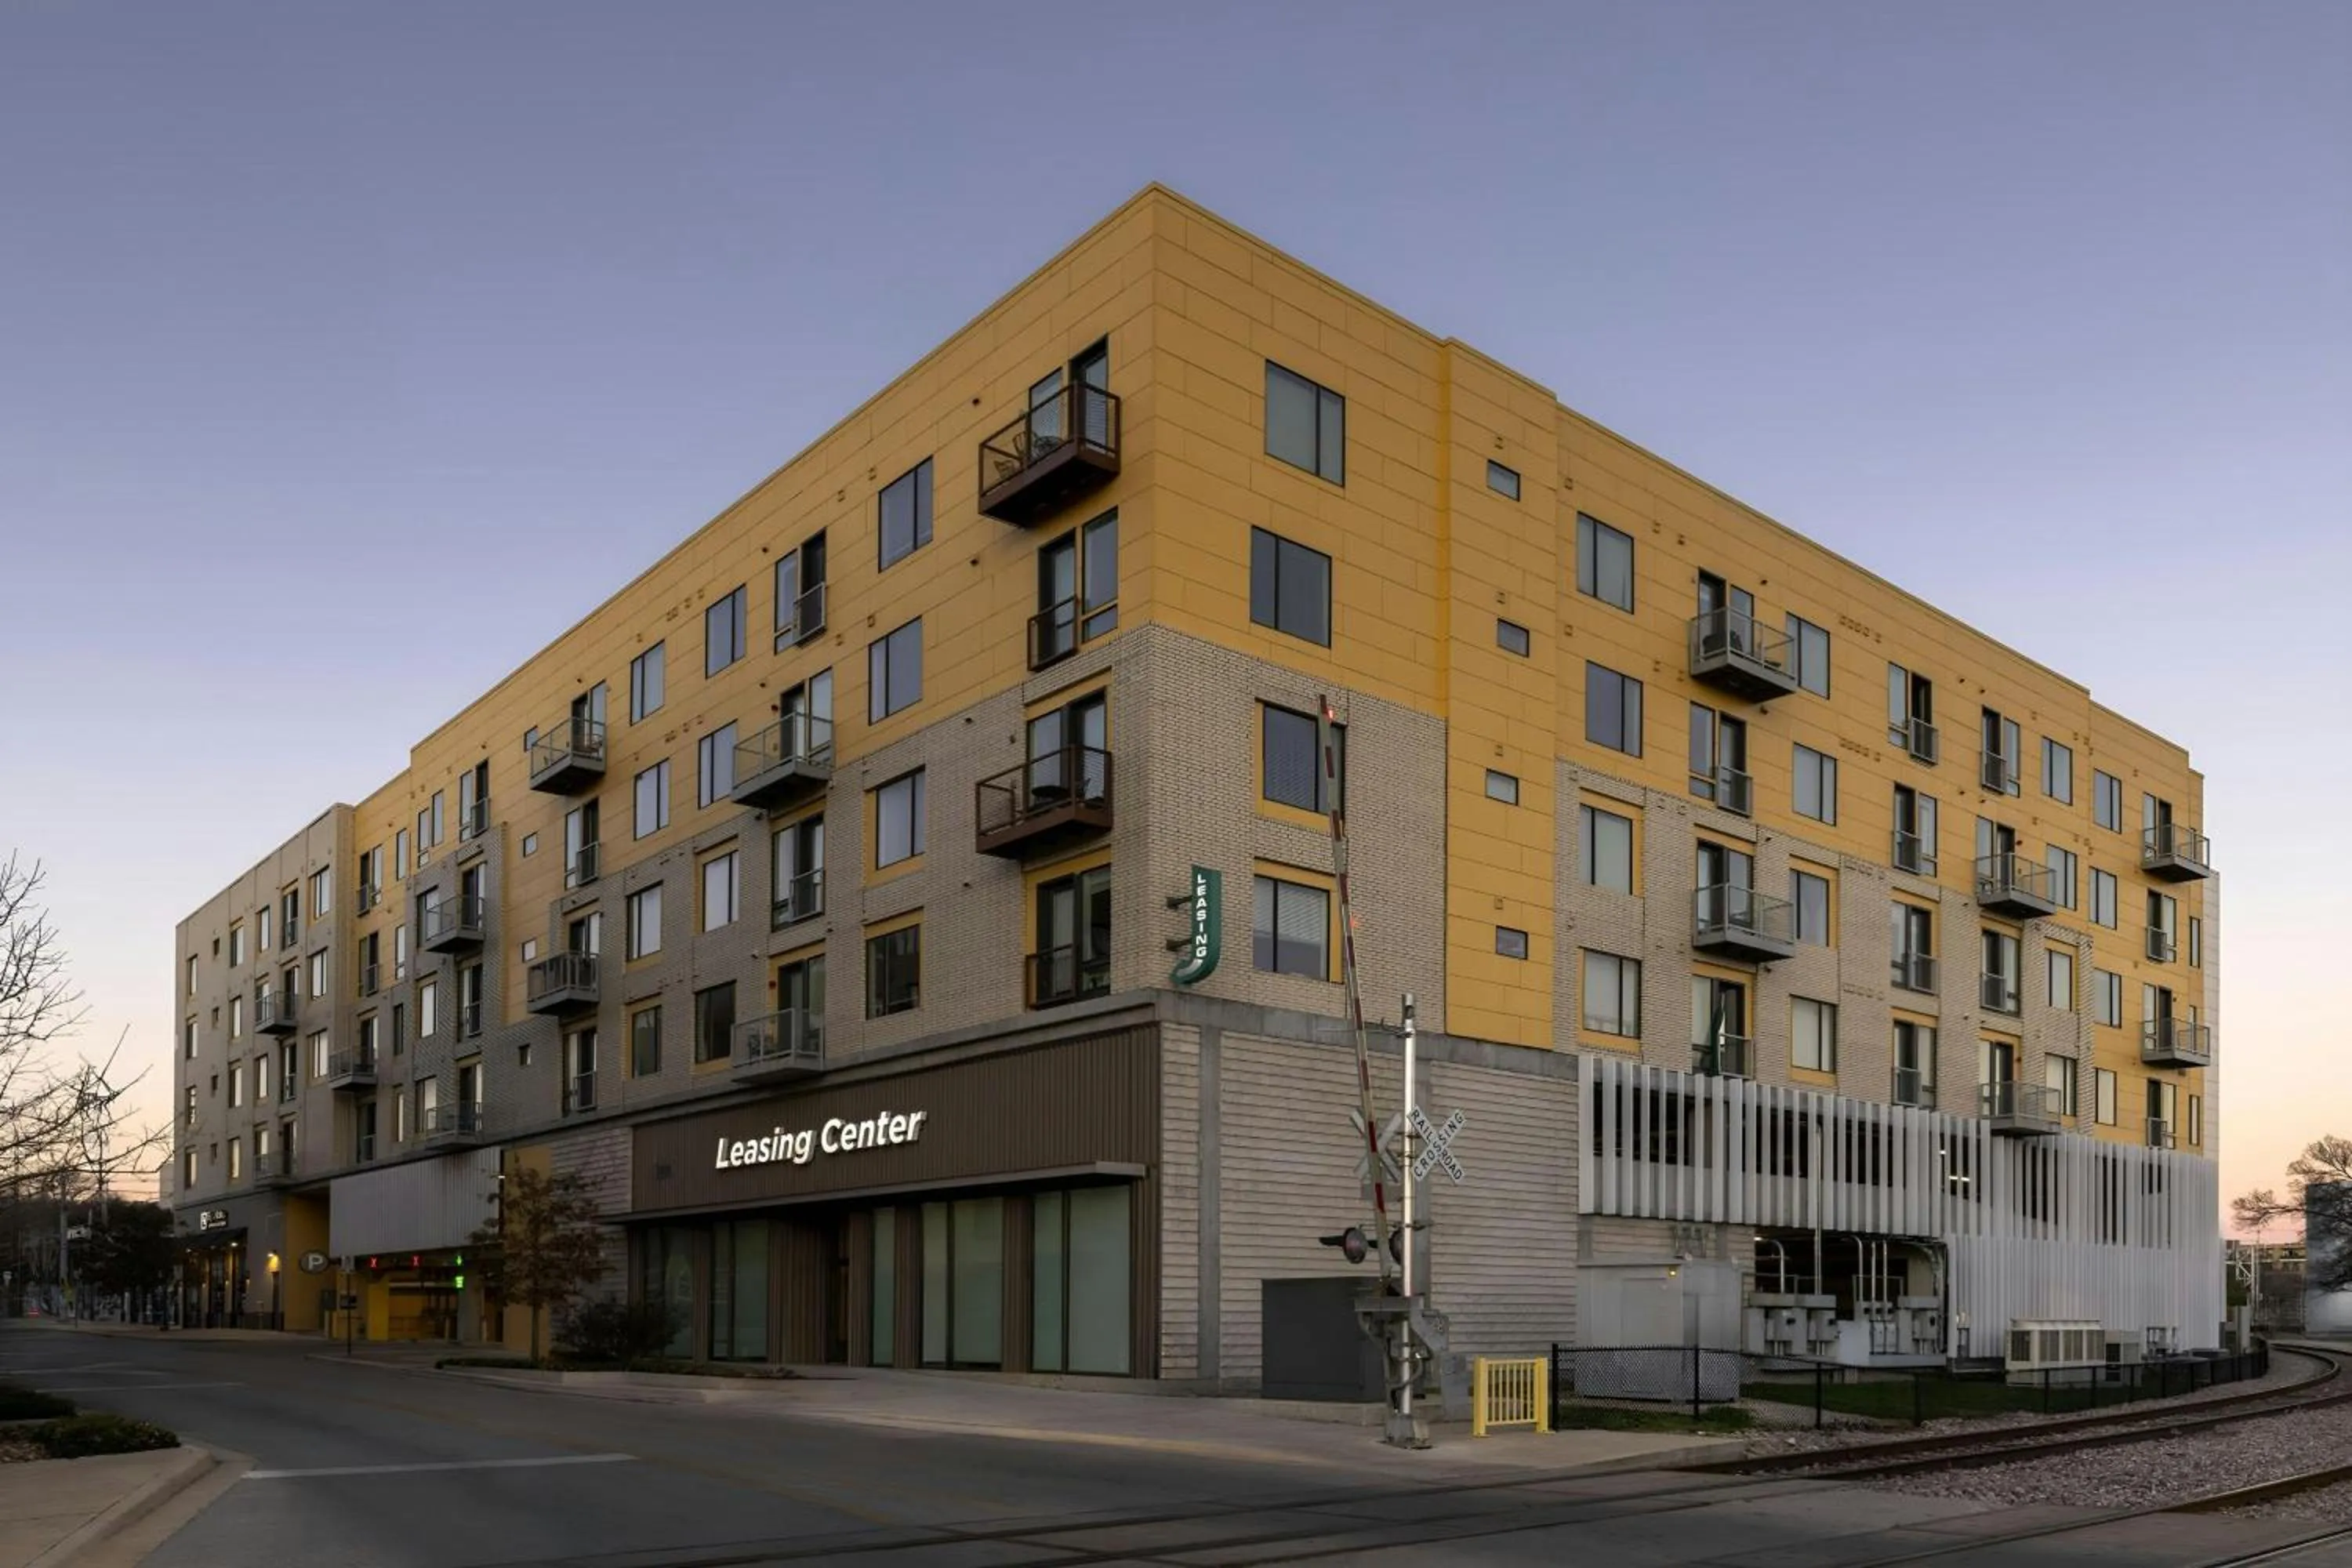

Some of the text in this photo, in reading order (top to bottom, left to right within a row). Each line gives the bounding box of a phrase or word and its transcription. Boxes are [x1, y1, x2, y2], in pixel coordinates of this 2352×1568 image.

[1196, 873, 1207, 957] LEASING
[715, 1111, 926, 1169] Leasing Center
[1411, 1109, 1462, 1180] RAIL ROAD
[1414, 1112, 1464, 1178] CROSSING
[308, 1253, 323, 1270] P
